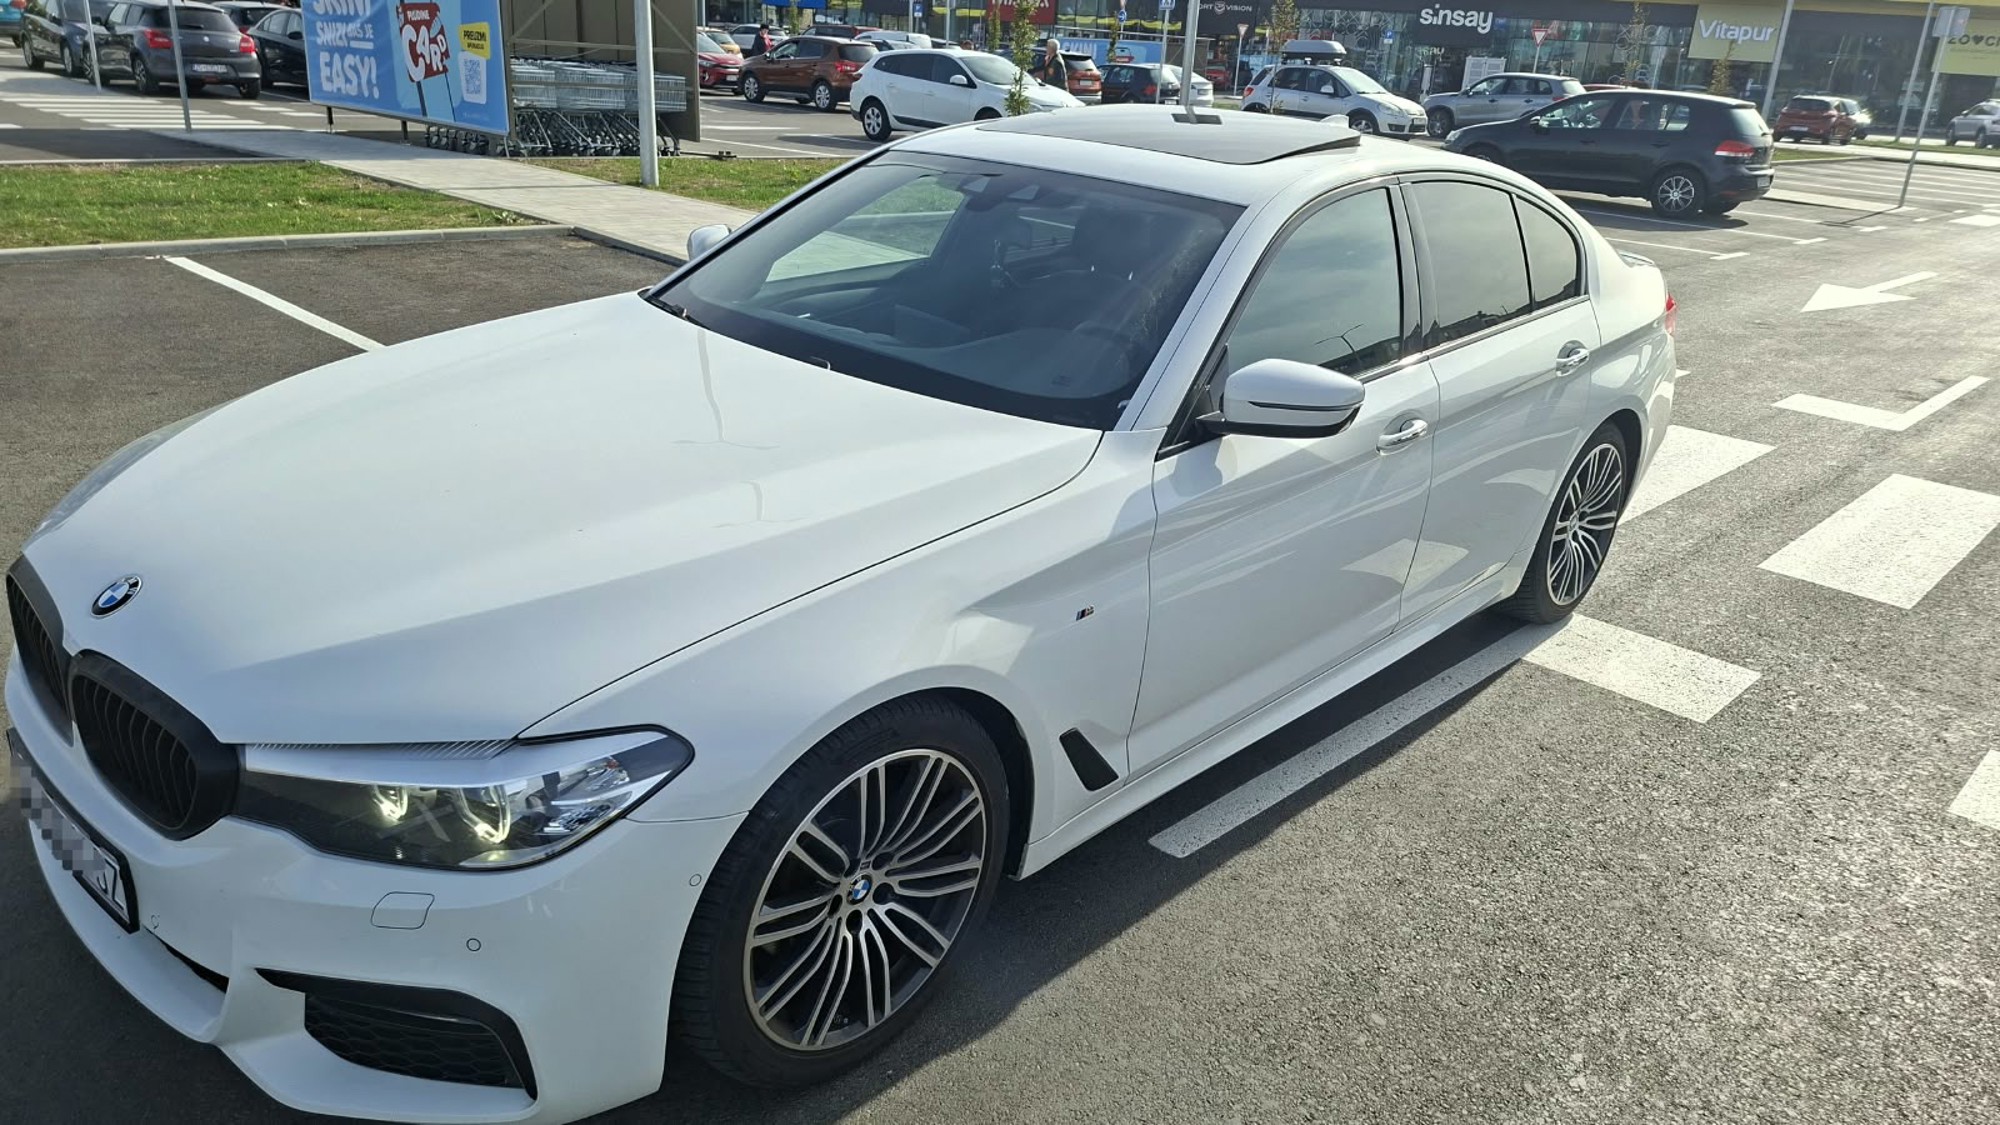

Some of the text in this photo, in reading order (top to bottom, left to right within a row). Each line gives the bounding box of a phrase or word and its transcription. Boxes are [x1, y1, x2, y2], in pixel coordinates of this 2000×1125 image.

[1225, 4, 1253, 12] VISION
[1420, 4, 1493, 34] sinsay
[1700, 20, 1774, 44] Vitapur
[320, 51, 379, 99] EASY!
